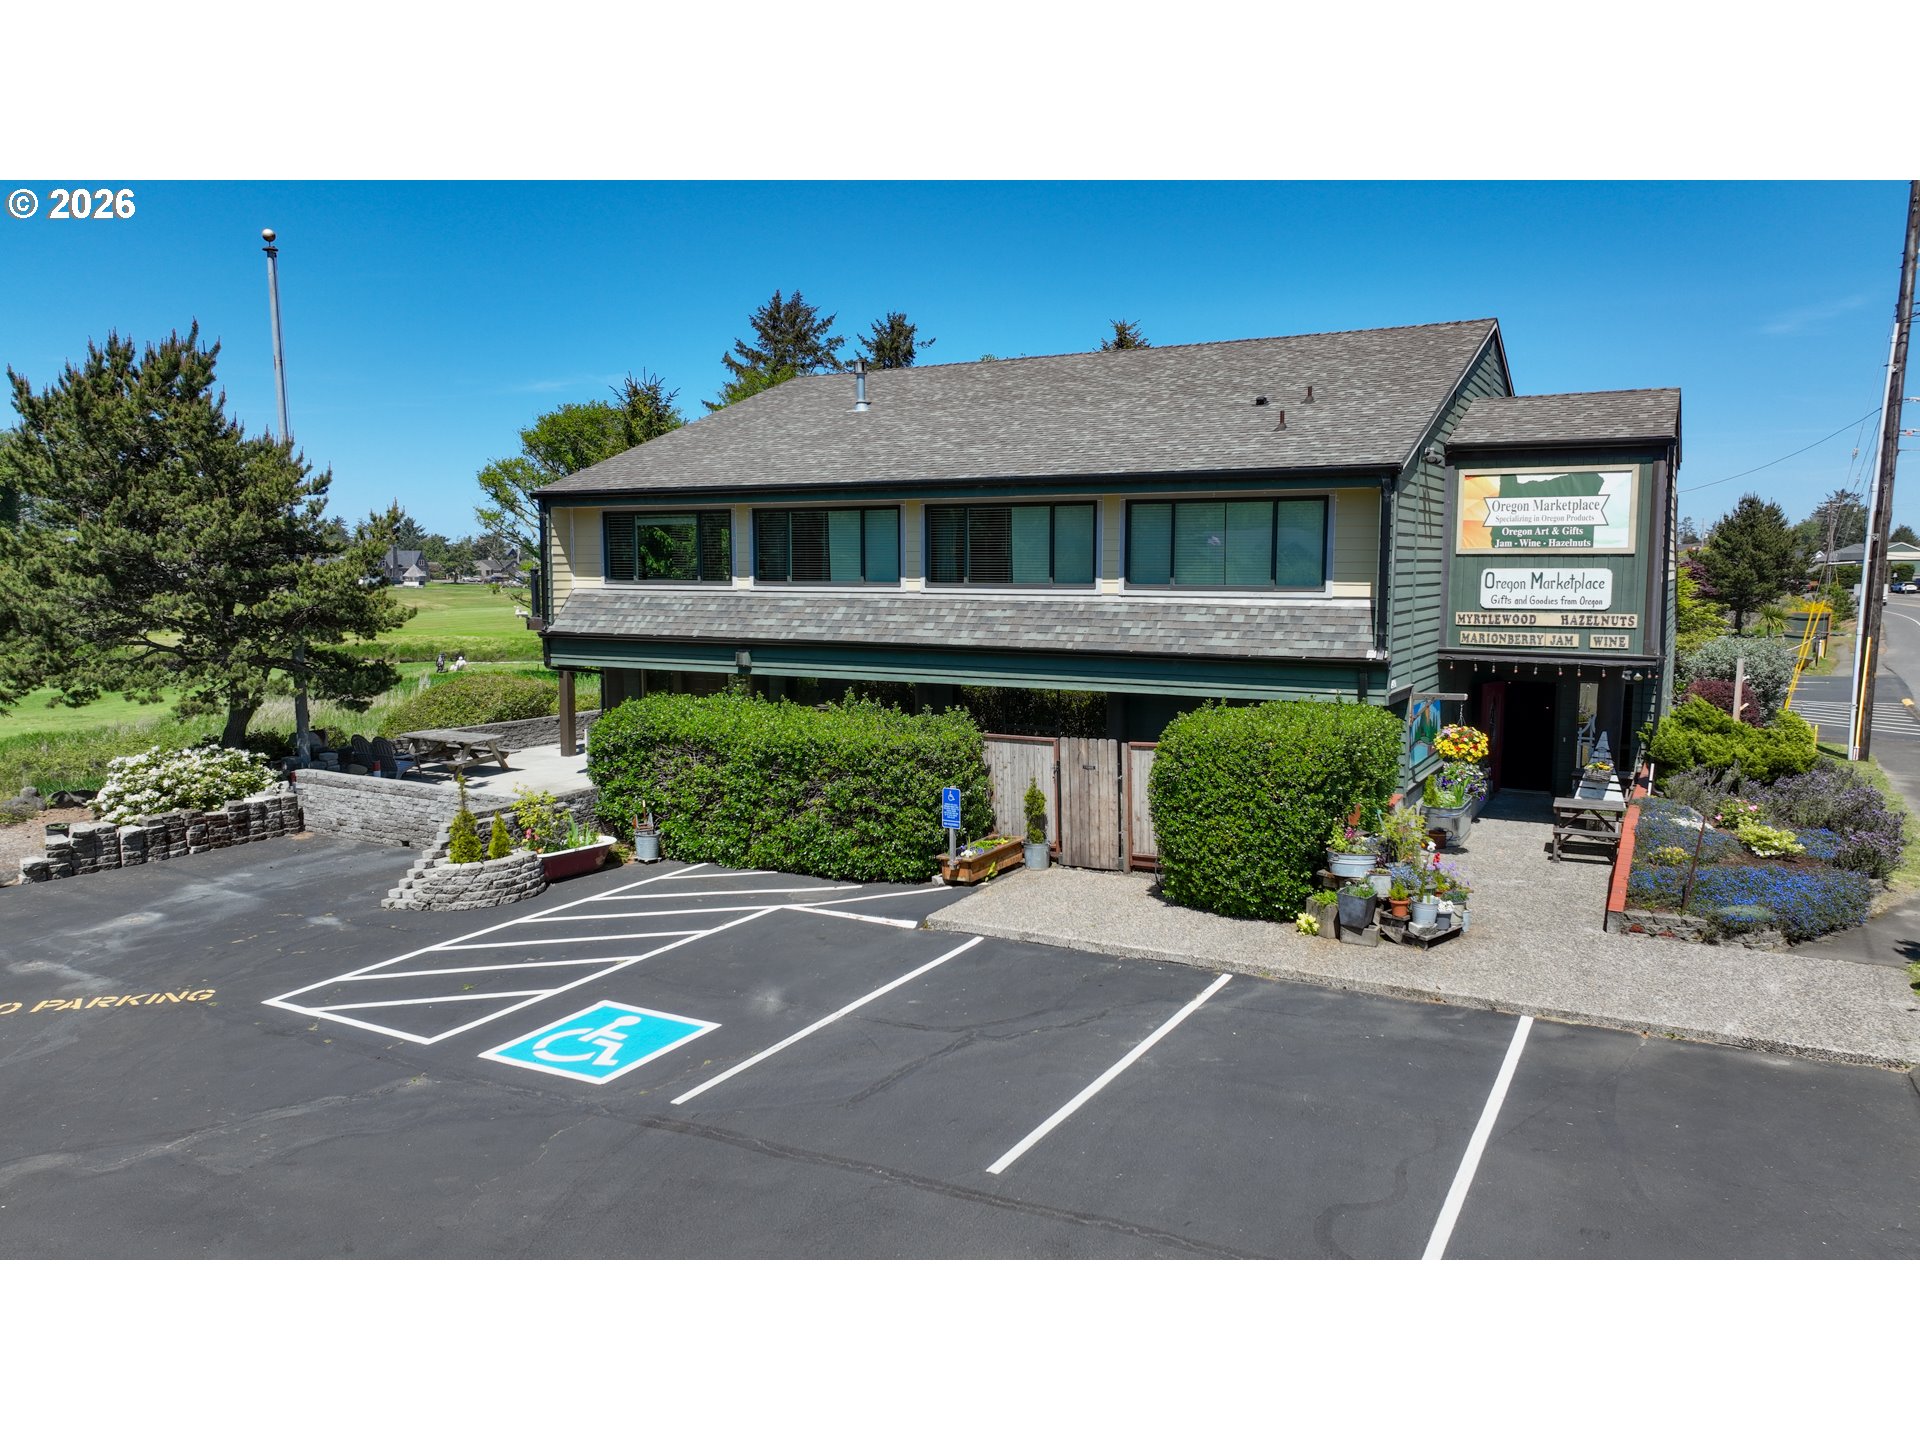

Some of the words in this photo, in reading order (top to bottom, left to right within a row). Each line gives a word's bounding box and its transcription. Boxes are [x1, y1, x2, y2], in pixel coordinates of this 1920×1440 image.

[1491, 499, 1530, 514] Oregon
[1533, 498, 1600, 514] Marketplace
[1495, 515, 1532, 524] Specializing
[1541, 514, 1565, 523] Oregon
[1566, 513, 1595, 522] Products
[1501, 526, 1533, 537] Oregon
[1534, 526, 1549, 535] Art
[1551, 526, 1560, 535] &
[1561, 526, 1584, 535] Gifts
[1494, 539, 1513, 548] Jam
[1519, 538, 1541, 547] Wine
[1548, 538, 1592, 547] Hazelnuts
[1484, 571, 1526, 593] Oregon
[1530, 571, 1606, 593] Marketplace
[1490, 594, 1512, 605] Gifts
[1514, 595, 1528, 605] and
[1529, 595, 1558, 605] Goodies
[1560, 595, 1578, 606] from
[1579, 596, 1603, 608] Oregon
[1457, 613, 1537, 625] MYRTLEWOOD
[1560, 614, 1636, 627] HAZELNUTS
[1460, 632, 1544, 645] MARIONBERRY
[1549, 635, 1574, 646] JAM
[1593, 636, 1626, 648] WINE
[0, 1002, 23, 1015] O
[29, 989, 216, 1013] PARKING
